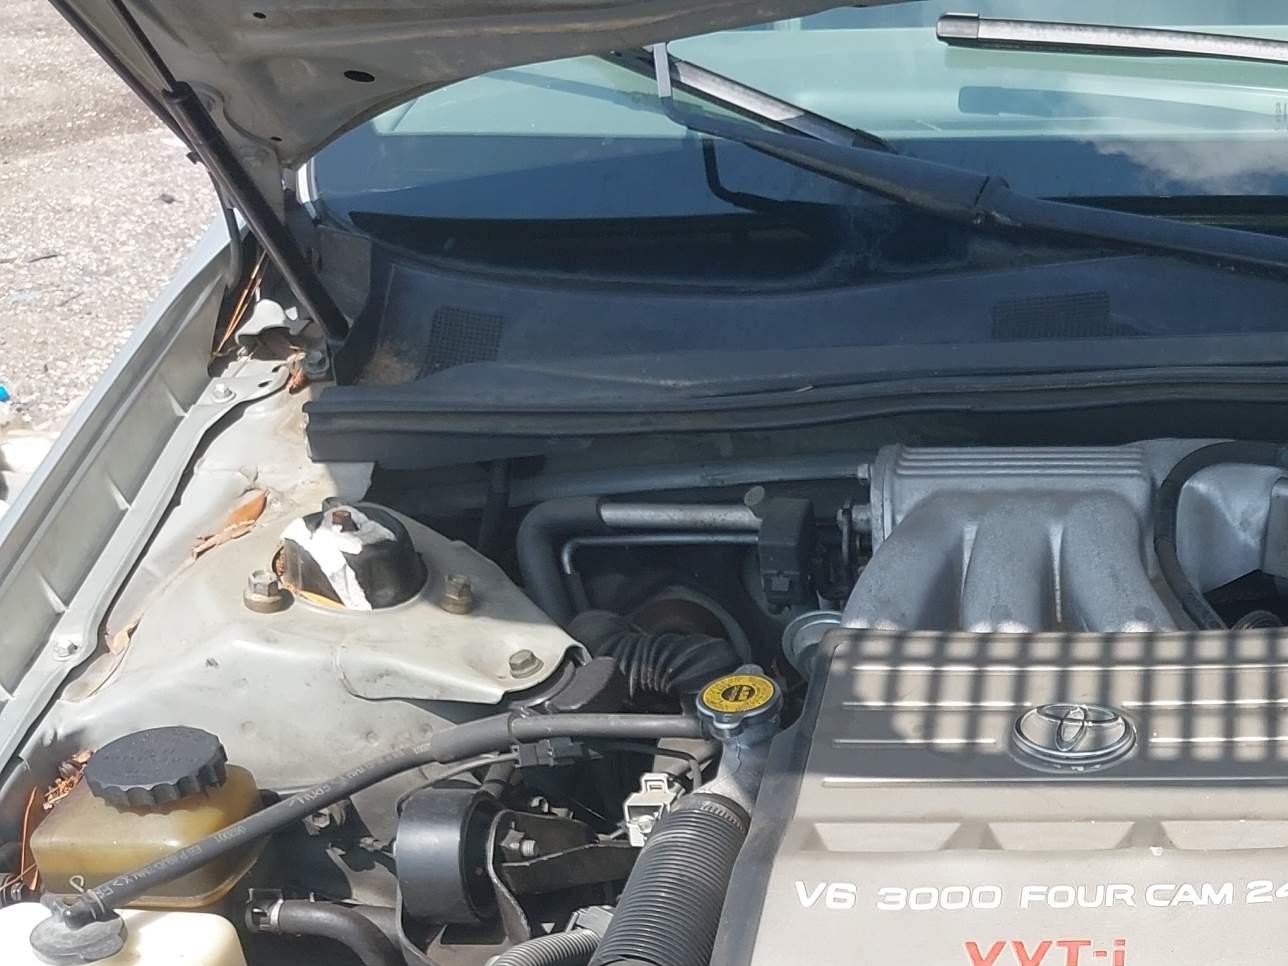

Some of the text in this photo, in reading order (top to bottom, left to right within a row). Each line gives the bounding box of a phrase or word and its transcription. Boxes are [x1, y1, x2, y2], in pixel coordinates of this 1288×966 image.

[795, 881, 857, 909] V6
[875, 884, 1002, 911] 3000
[1020, 883, 1138, 909] FOUR
[1144, 882, 1235, 908] CAM
